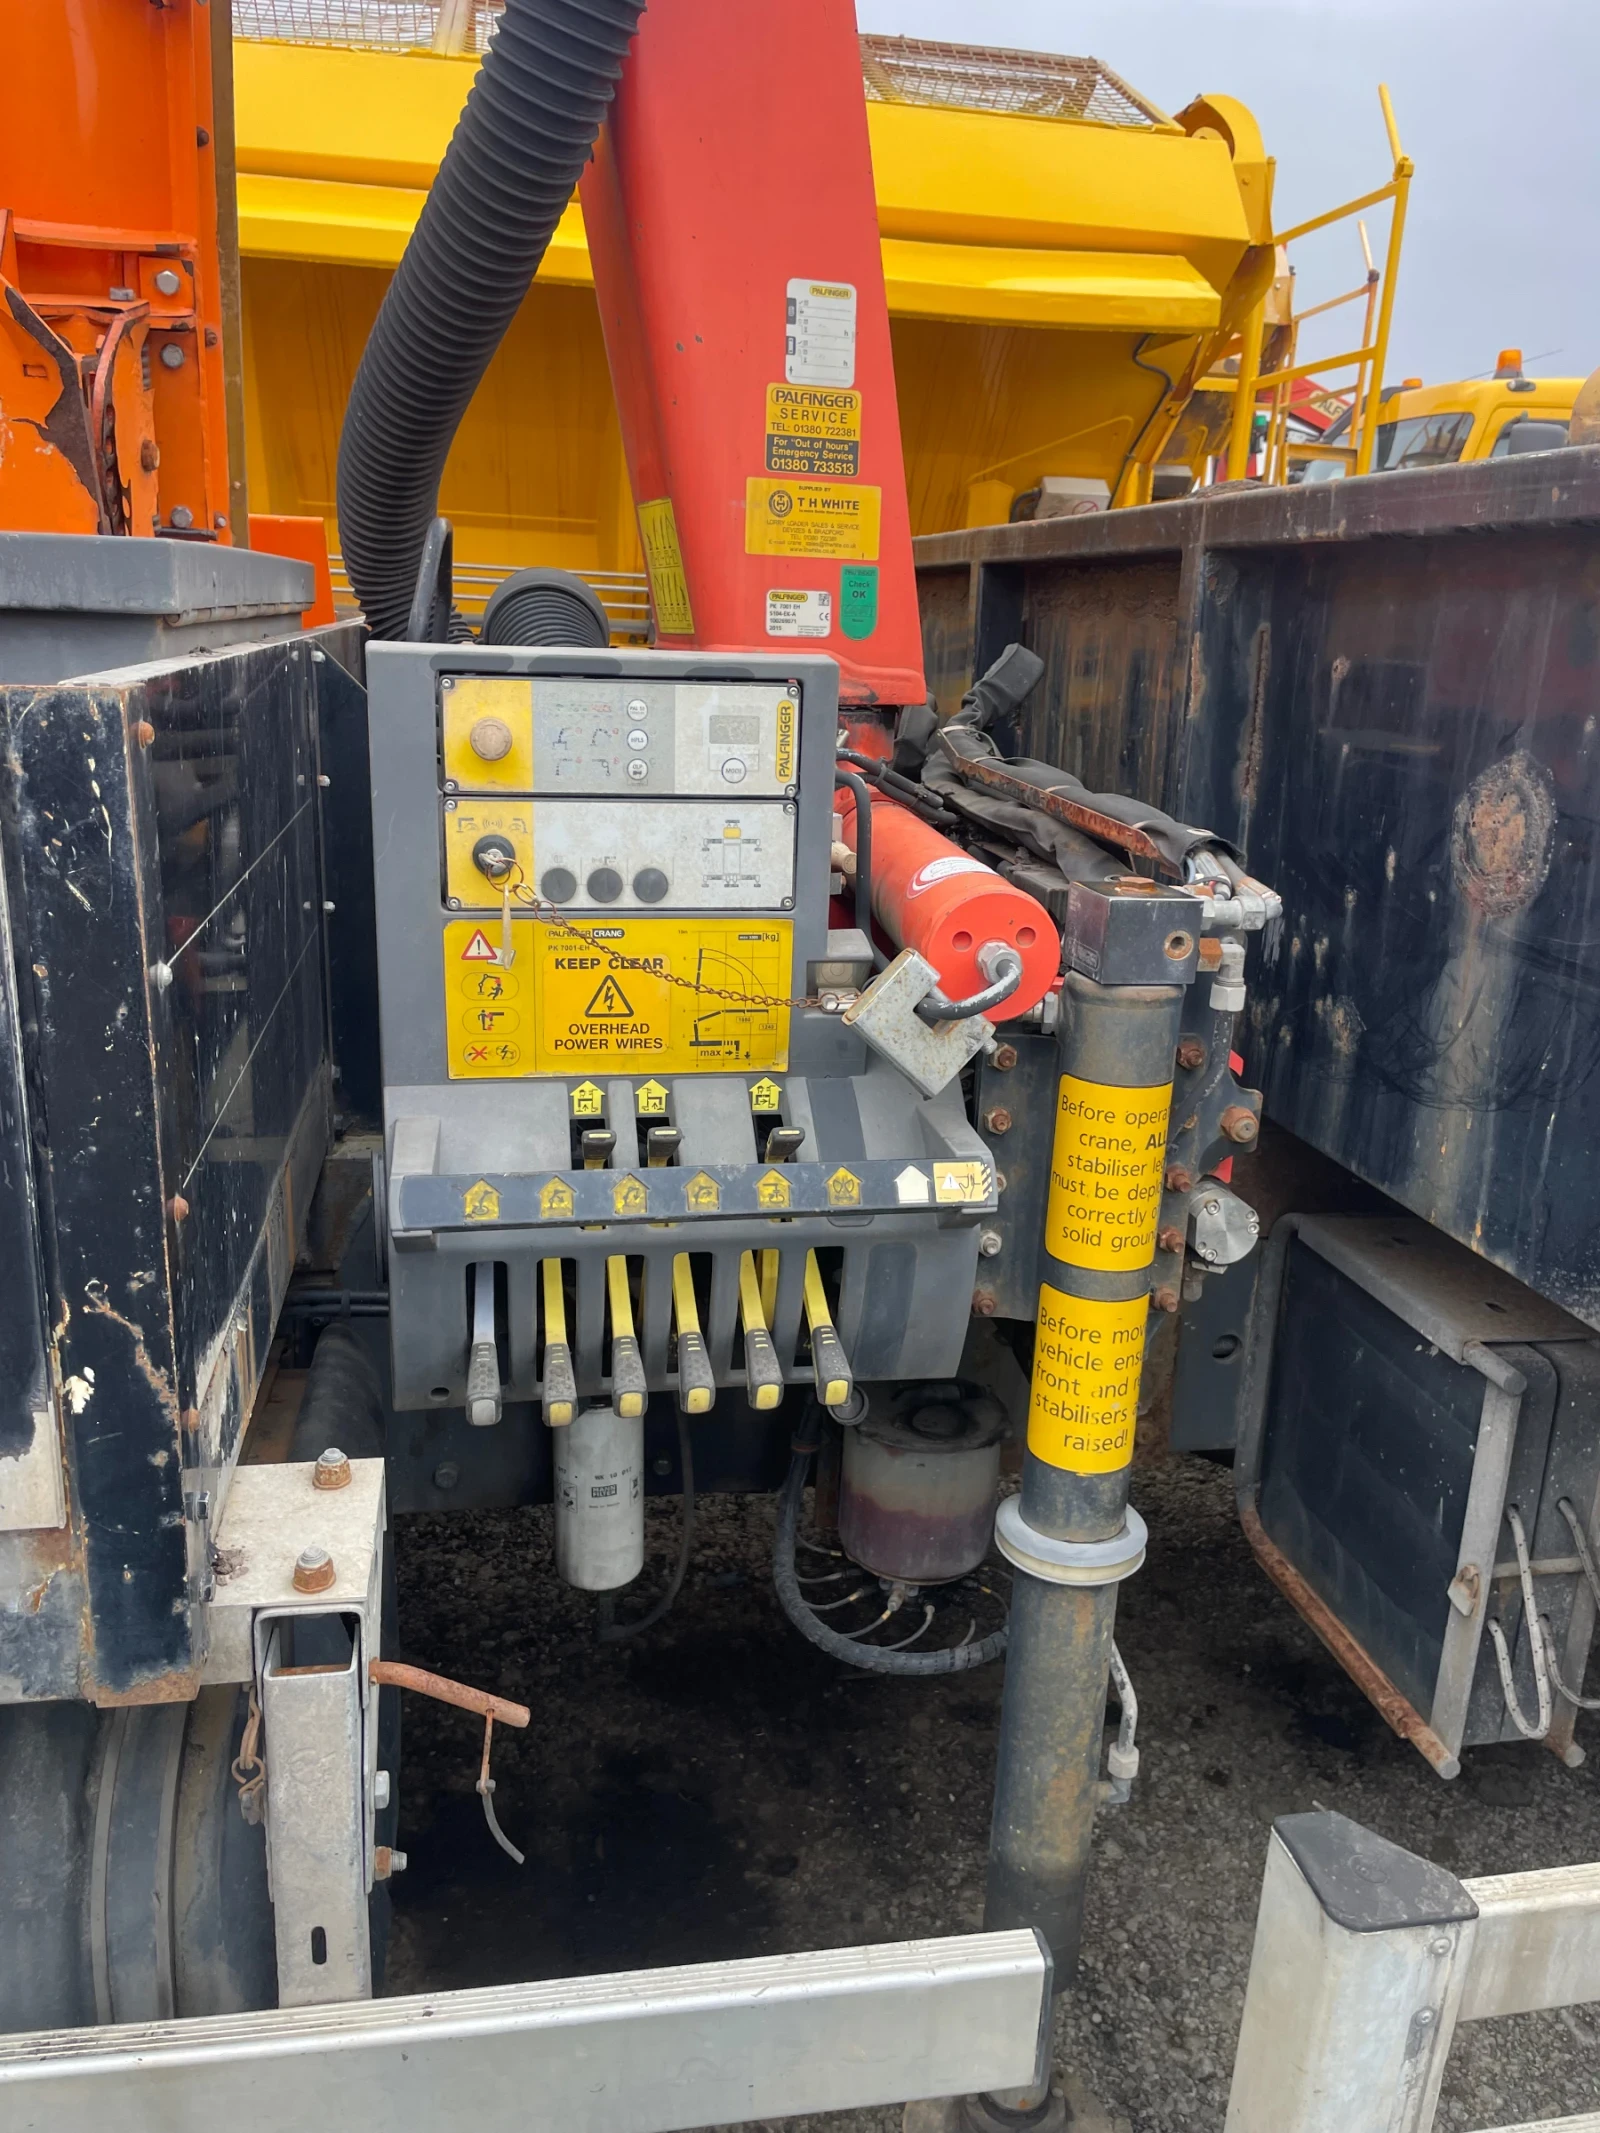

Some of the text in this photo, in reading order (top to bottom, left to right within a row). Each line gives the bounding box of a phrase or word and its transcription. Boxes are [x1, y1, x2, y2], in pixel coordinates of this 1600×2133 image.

[811, 287, 849, 298] PALFINGER
[775, 389, 854, 409] PALFINGER
[779, 407, 848, 424] SERVICE
[793, 424, 822, 435] 01380
[825, 426, 856, 437] 722381
[773, 436, 788, 446] For
[813, 440, 822, 449] of
[772, 446, 854, 461] Emergency Service
[771, 457, 854, 475] 01380 733513
[797, 497, 860, 511] T H WHITE
[811, 521, 828, 529] SALES
[813, 528, 845, 536] BRADFORD
[848, 580, 870, 588] Check
[771, 593, 806, 601] PALFINGER
[852, 590, 867, 599] OK
[779, 706, 791, 777] PALFINGER
[548, 929, 623, 938] PALFINER CRANE
[762, 932, 780, 942] [kg]
[555, 957, 601, 969] KEEP
[608, 957, 664, 970] CLEAR
[568, 1023, 650, 1035] OVERHEAD
[554, 1037, 663, 1050] POWER WIRES
[1061, 1094, 1170, 1129] Before opera
[1079, 1133, 1137, 1154] crane,
[1067, 1154, 1148, 1177] stabiliser
[1052, 1170, 1086, 1196] must
[1094, 1181, 1119, 1201] be
[1067, 1204, 1147, 1228] correctly
[1062, 1226, 1102, 1247] solid
[1040, 1306, 1102, 1344] Before
[1040, 1339, 1104, 1372] vehicle
[1036, 1360, 1081, 1396] front
[1091, 1376, 1128, 1398] and
[1035, 1392, 1128, 1425] stabilisers
[1063, 1428, 1128, 1452] raised!
